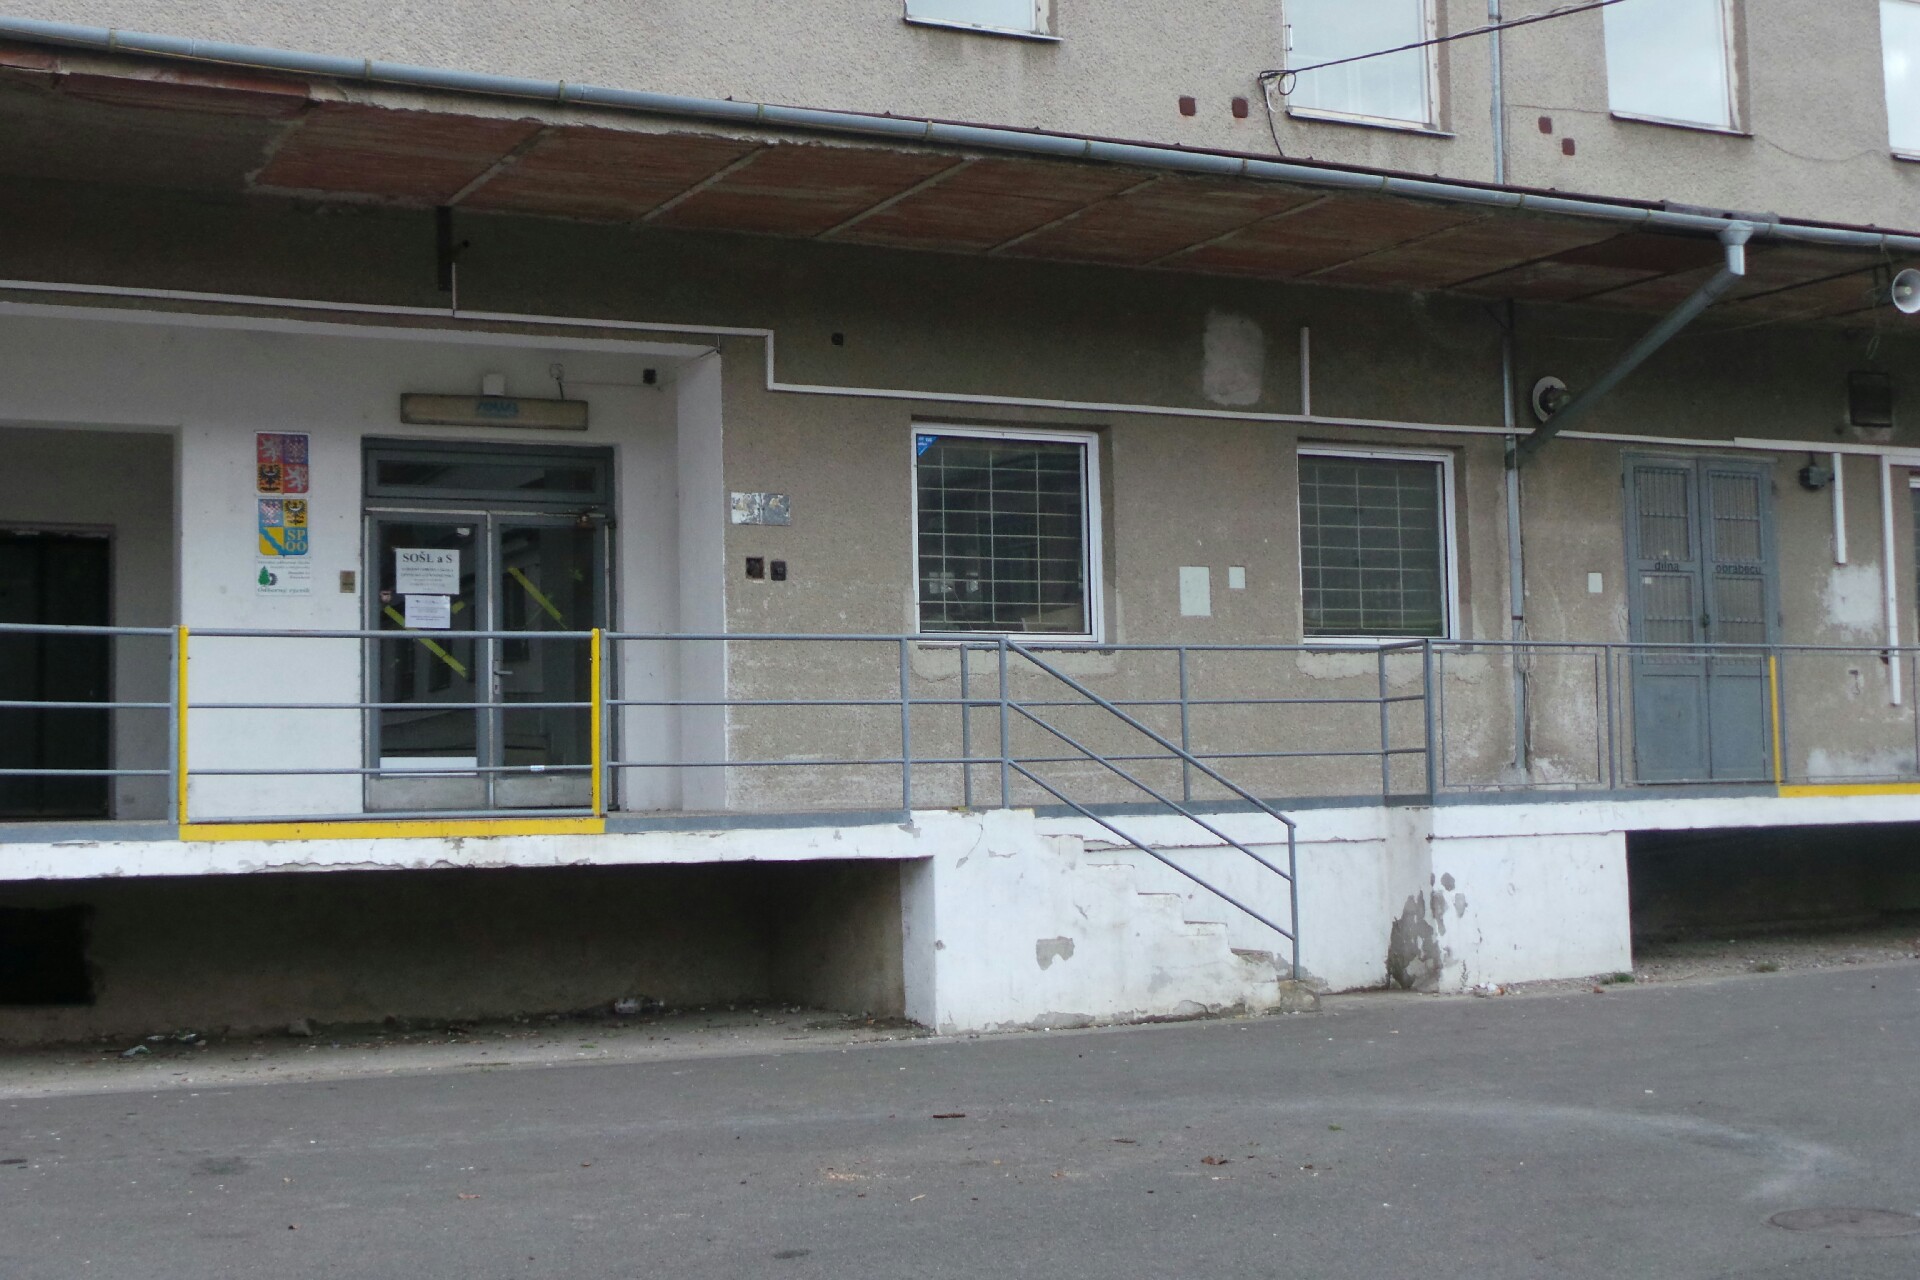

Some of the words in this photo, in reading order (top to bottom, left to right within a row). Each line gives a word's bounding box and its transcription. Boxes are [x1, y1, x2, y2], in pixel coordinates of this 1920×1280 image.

[402, 551, 434, 563] SOŠL
[437, 555, 443, 563] a
[446, 554, 453, 564] S
